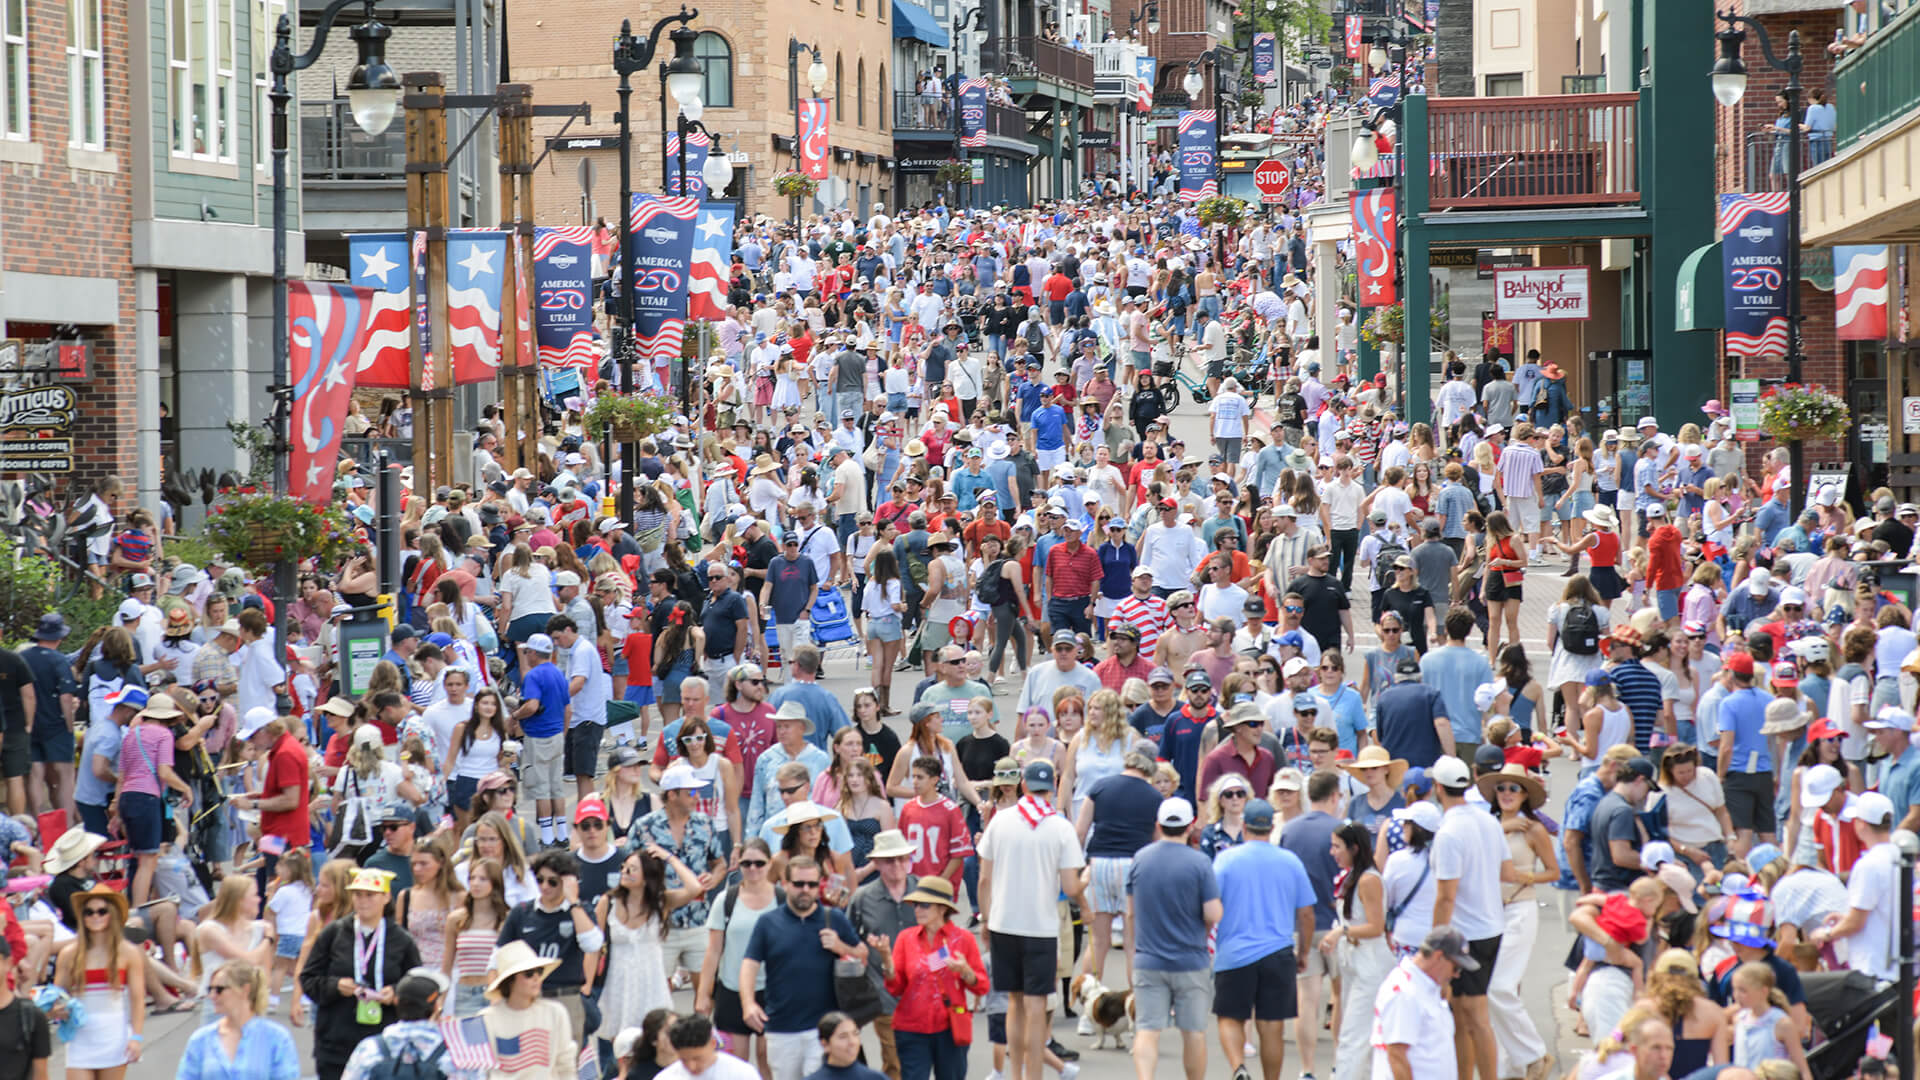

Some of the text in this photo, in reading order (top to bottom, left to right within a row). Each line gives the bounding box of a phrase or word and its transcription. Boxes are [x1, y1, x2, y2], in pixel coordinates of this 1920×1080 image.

[1183, 152, 1212, 166] 250
[1256, 170, 1288, 185] STOP
[635, 256, 683, 268] AMERICA
[1731, 256, 1782, 266] AMERICA
[541, 280, 585, 289] AMERICA
[634, 268, 681, 293] 250
[1731, 266, 1782, 291] 250
[540, 289, 586, 311] 250
[640, 296, 668, 306] UTAH
[1743, 295, 1773, 305] UTAH
[549, 314, 577, 322] UTAH
[38, 442, 69, 451] COFFEE
[40, 460, 68, 469] GIFTS
[908, 823, 940, 864] 91
[539, 942, 560, 959] 10
